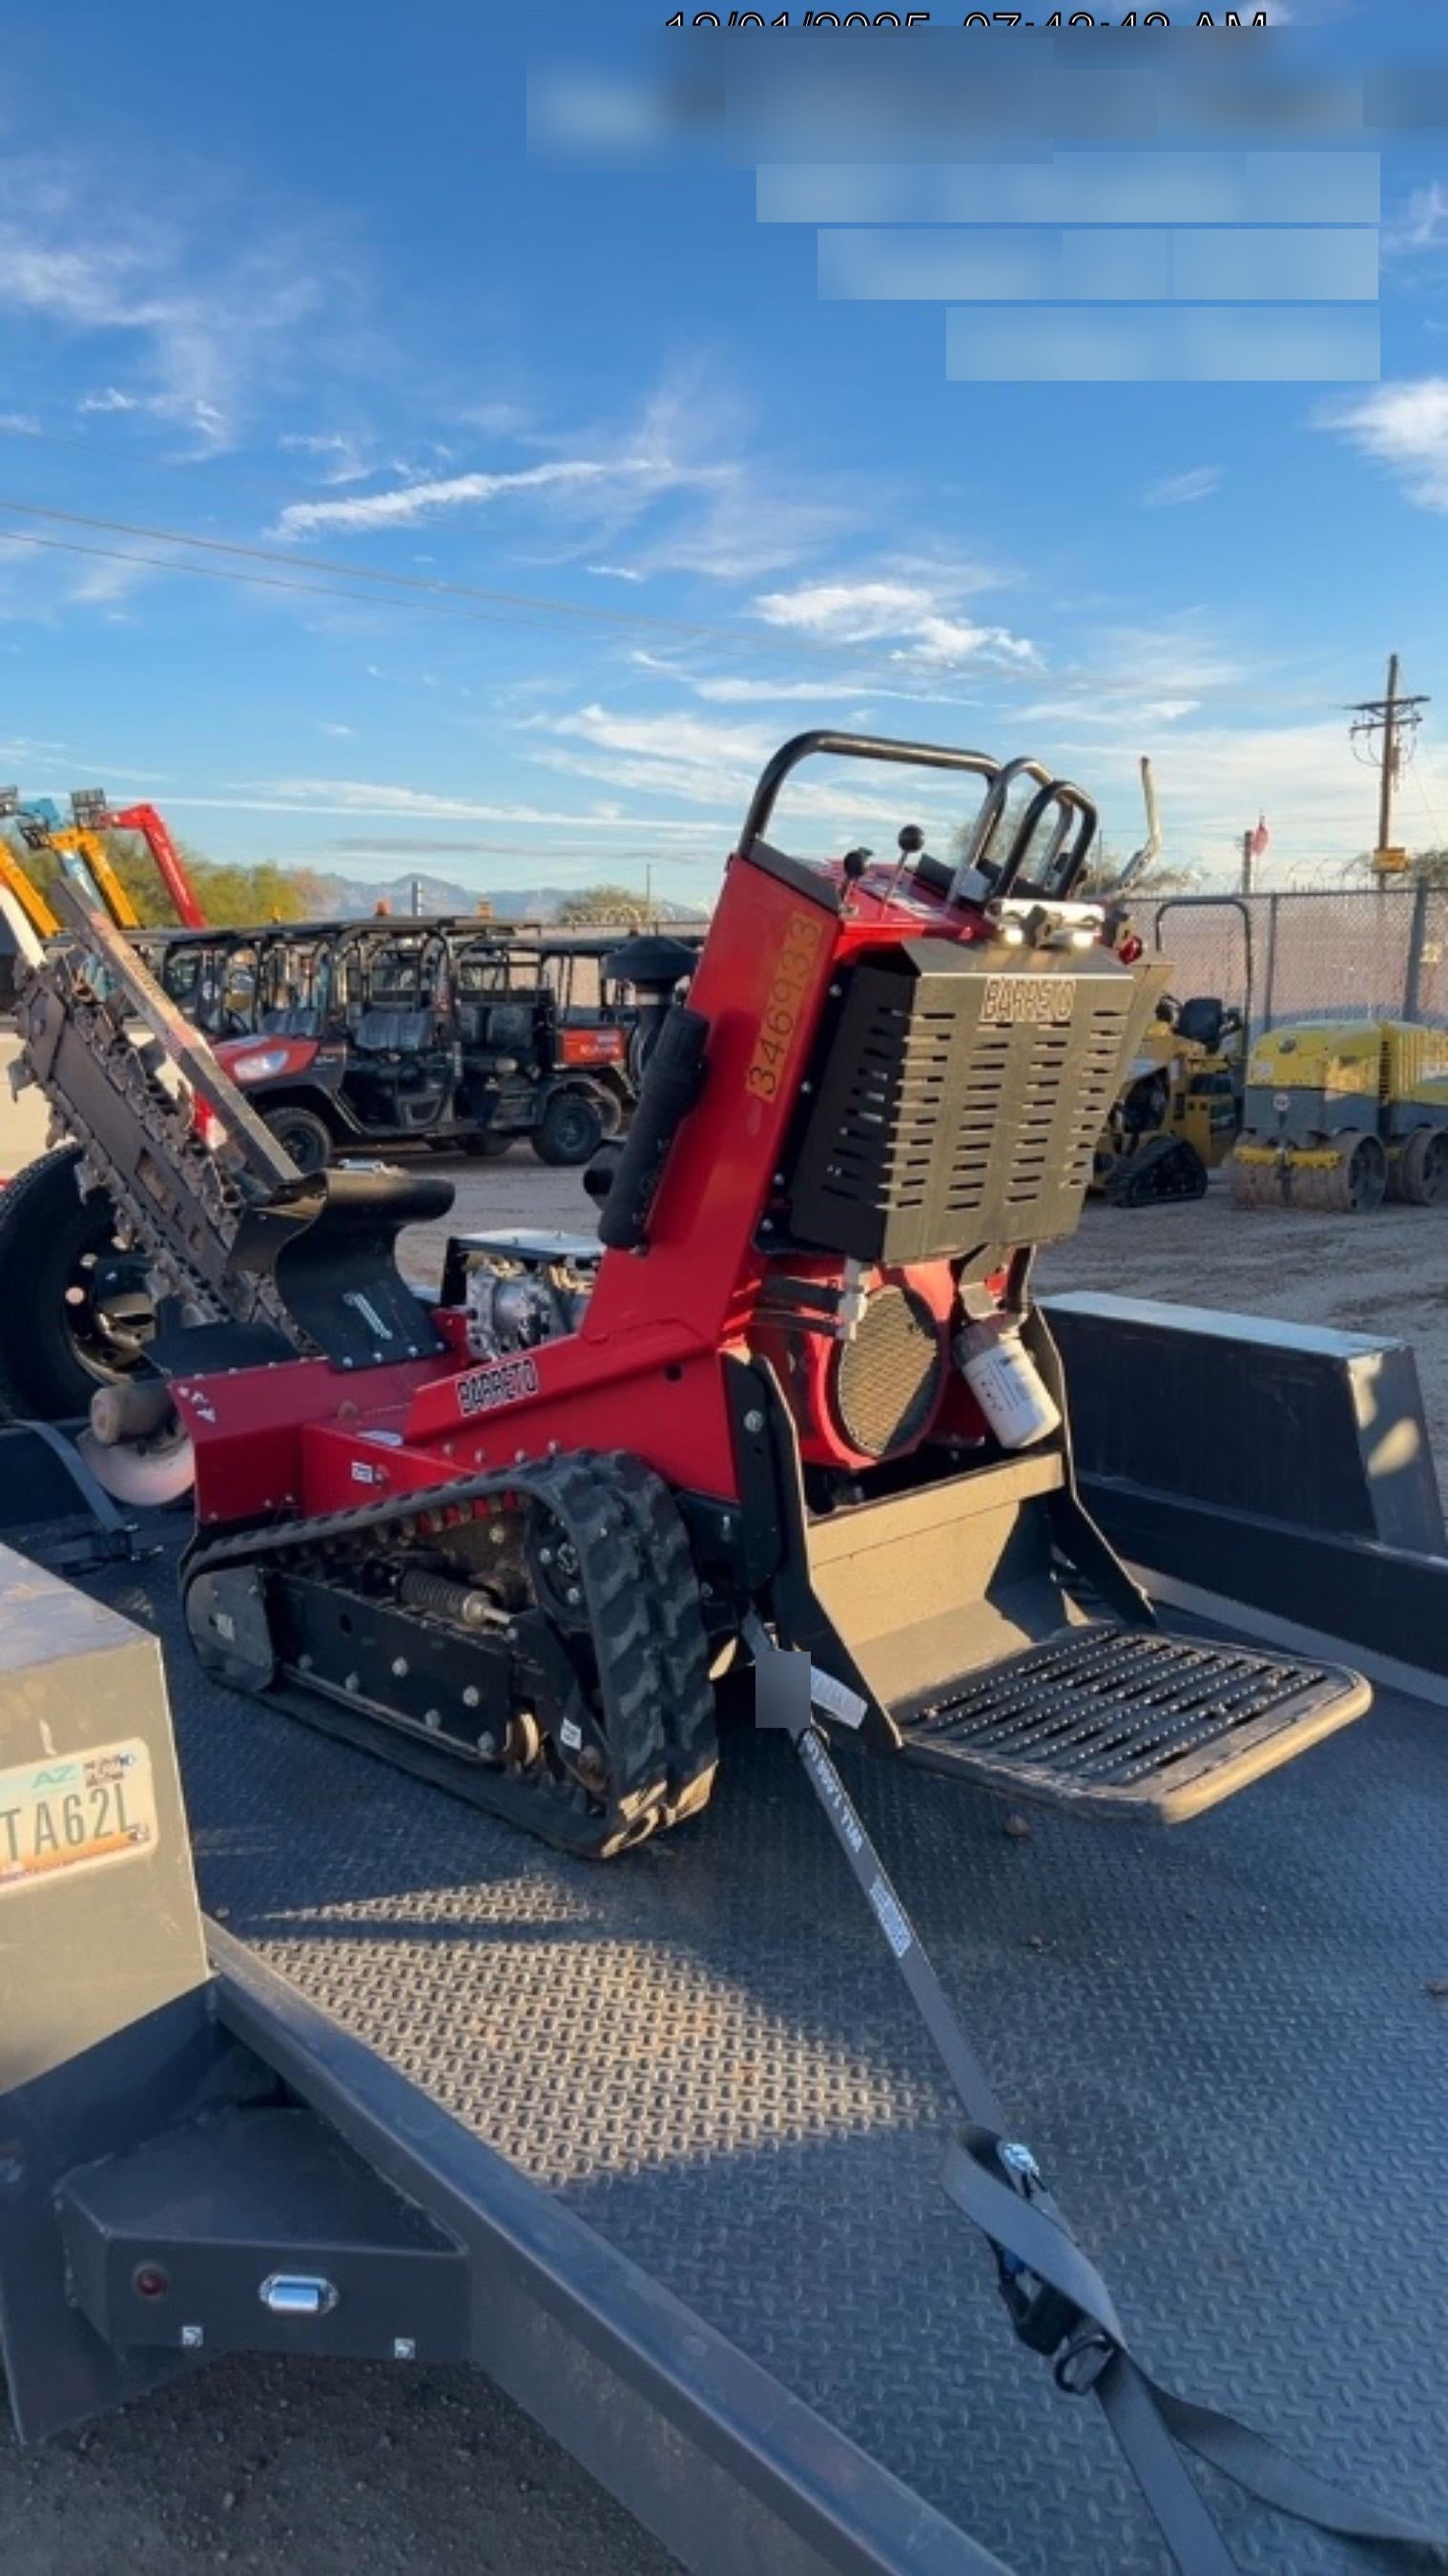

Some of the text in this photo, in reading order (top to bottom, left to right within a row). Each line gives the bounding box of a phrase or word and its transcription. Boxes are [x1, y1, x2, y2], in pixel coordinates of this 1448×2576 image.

[748, 919, 818, 1094] 346933
[457, 1358, 538, 1416] BARRETO
[33, 1765, 76, 1788] AZ
